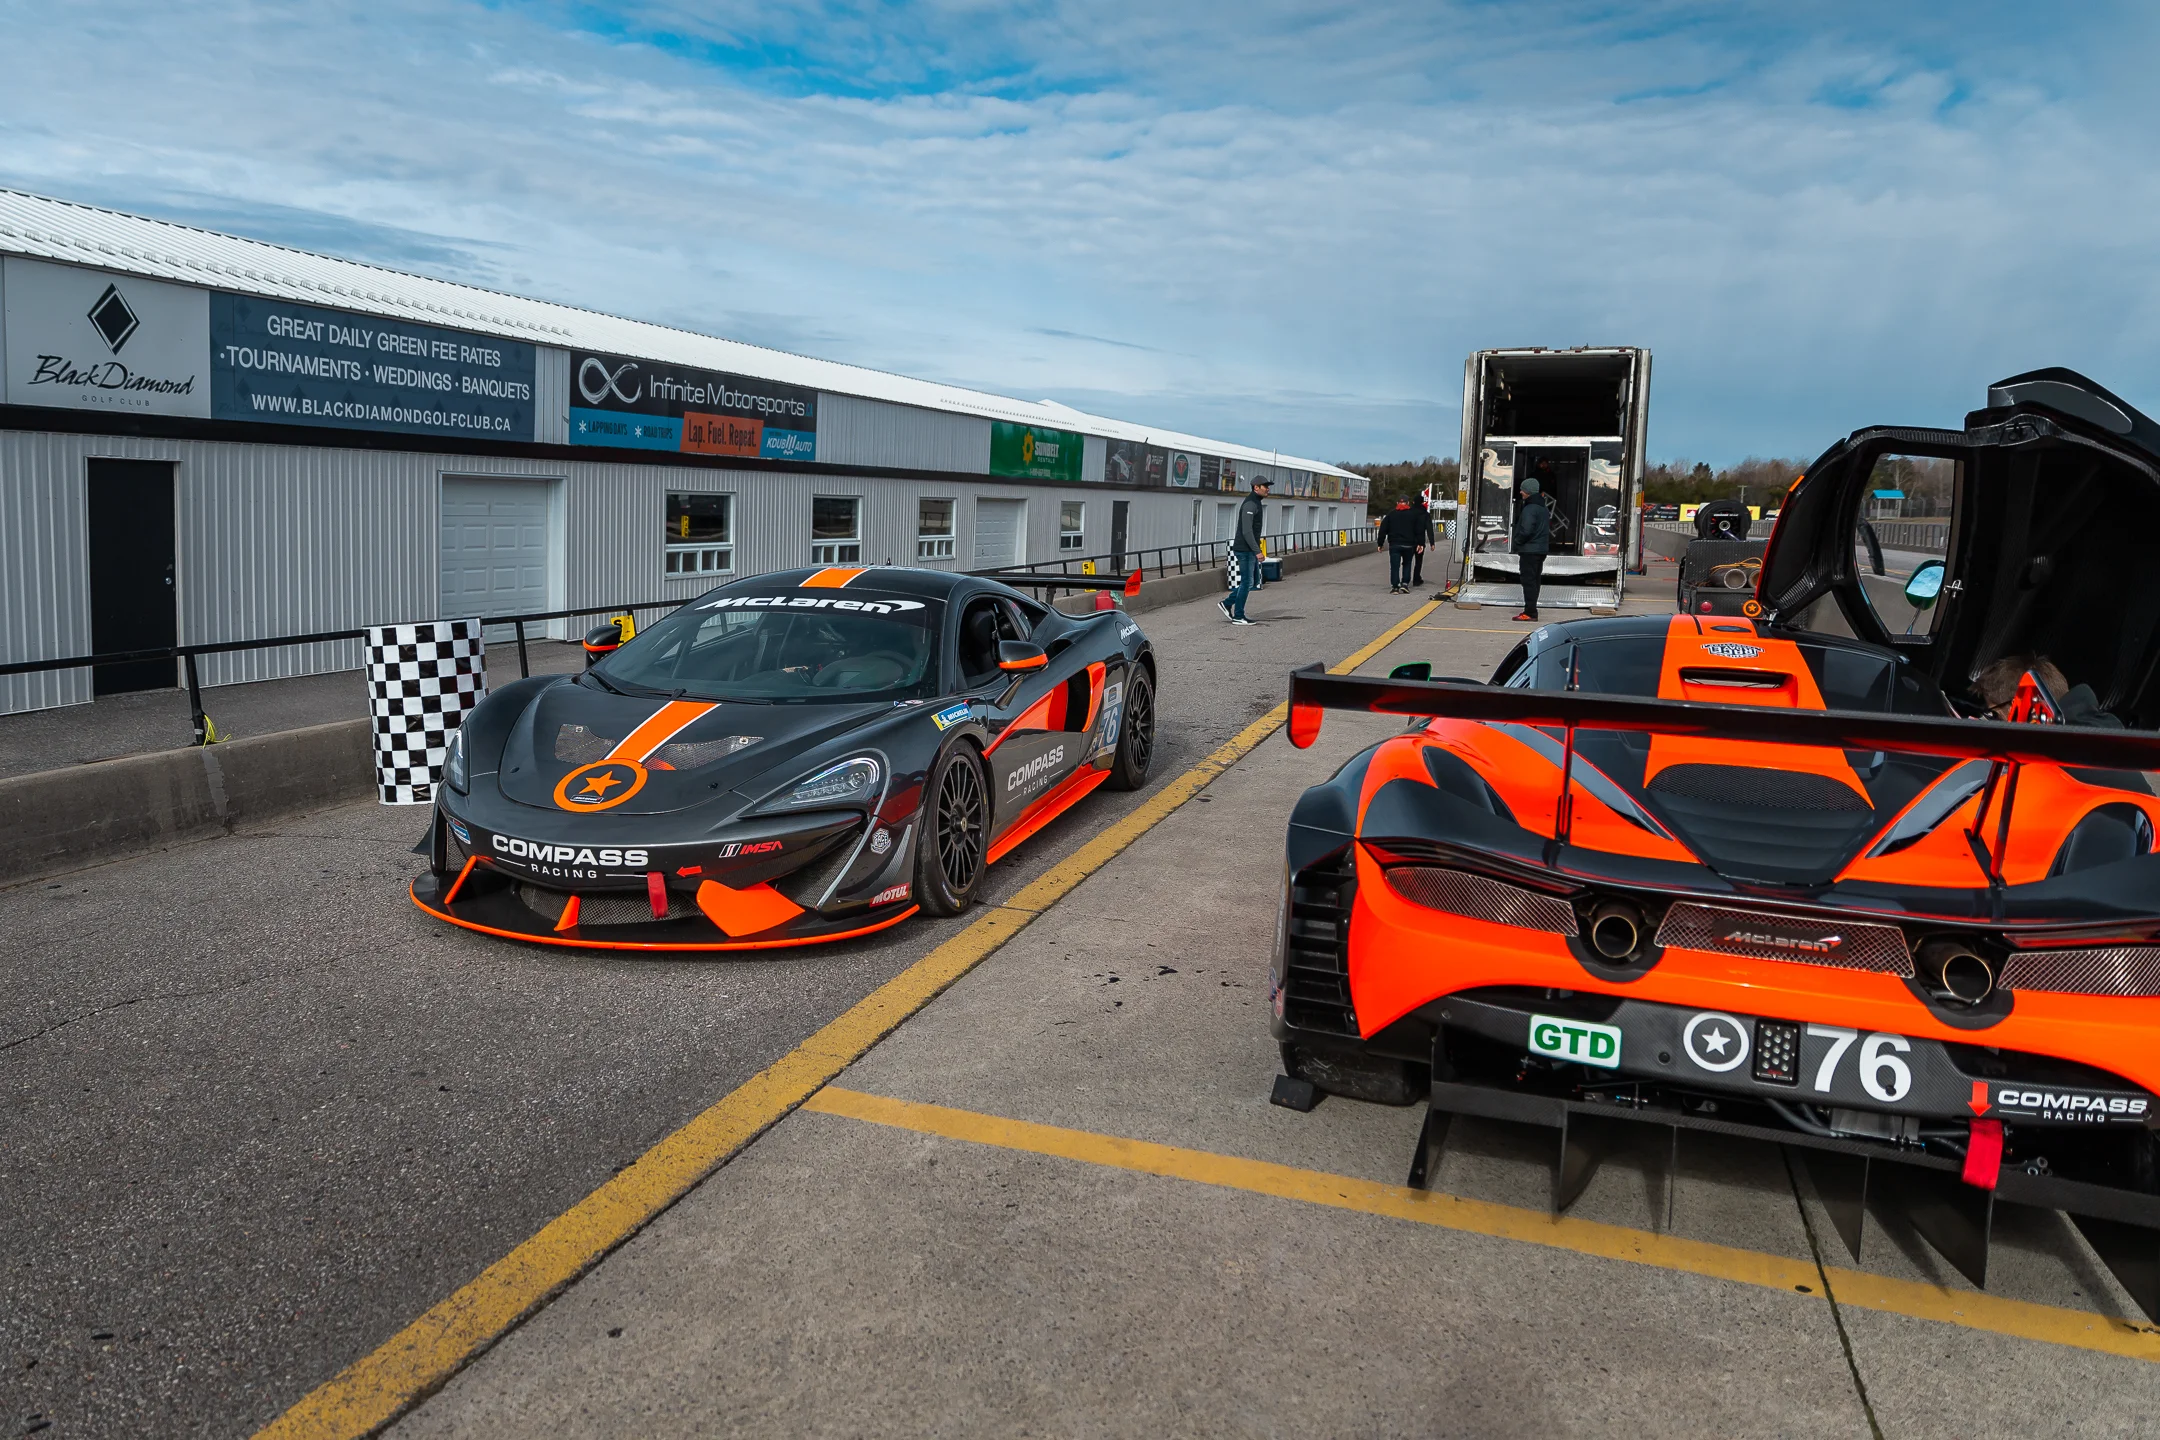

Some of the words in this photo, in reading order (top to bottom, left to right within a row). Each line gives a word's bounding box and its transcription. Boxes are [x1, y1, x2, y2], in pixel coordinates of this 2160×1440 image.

[267, 315, 324, 341] GREAT
[329, 325, 373, 348] DAILY
[377, 332, 427, 357] GREEN
[431, 340, 457, 361] FEE
[461, 345, 500, 367] RATES
[225, 345, 361, 380] TOURNAMENTS
[373, 364, 452, 391] WEDDINGS
[462, 376, 529, 400] BANQUETS
[82, 394, 113, 404] GOLF
[120, 397, 150, 407] CLUB
[252, 393, 511, 431] WWW.BLACKDIAMONDGOLFCLUB.CA
[613, 422, 628, 436] DAYS
[643, 425, 657, 438] ROAD
[688, 419, 705, 448] Lap.
[708, 421, 726, 445] Fuel.
[729, 423, 756, 451] Repeat.
[1034, 441, 1060, 458] SUNBELT
[694, 596, 893, 614] McLaren
[947, 708, 969, 720] MICHELIN
[1007, 744, 1064, 791] COMPASS
[1023, 775, 1048, 796] RACING
[492, 834, 649, 867] COMPASS
[740, 840, 783, 855] IMSA
[531, 863, 598, 879] RACING
[872, 885, 907, 905] MOTUL
[1724, 931, 1829, 953] McLaren
[1534, 1023, 1615, 1059] GTD
[1806, 1022, 1912, 1102] 76
[1998, 1090, 2148, 1115] COMPASS
[2043, 1111, 2105, 1122] RACING
